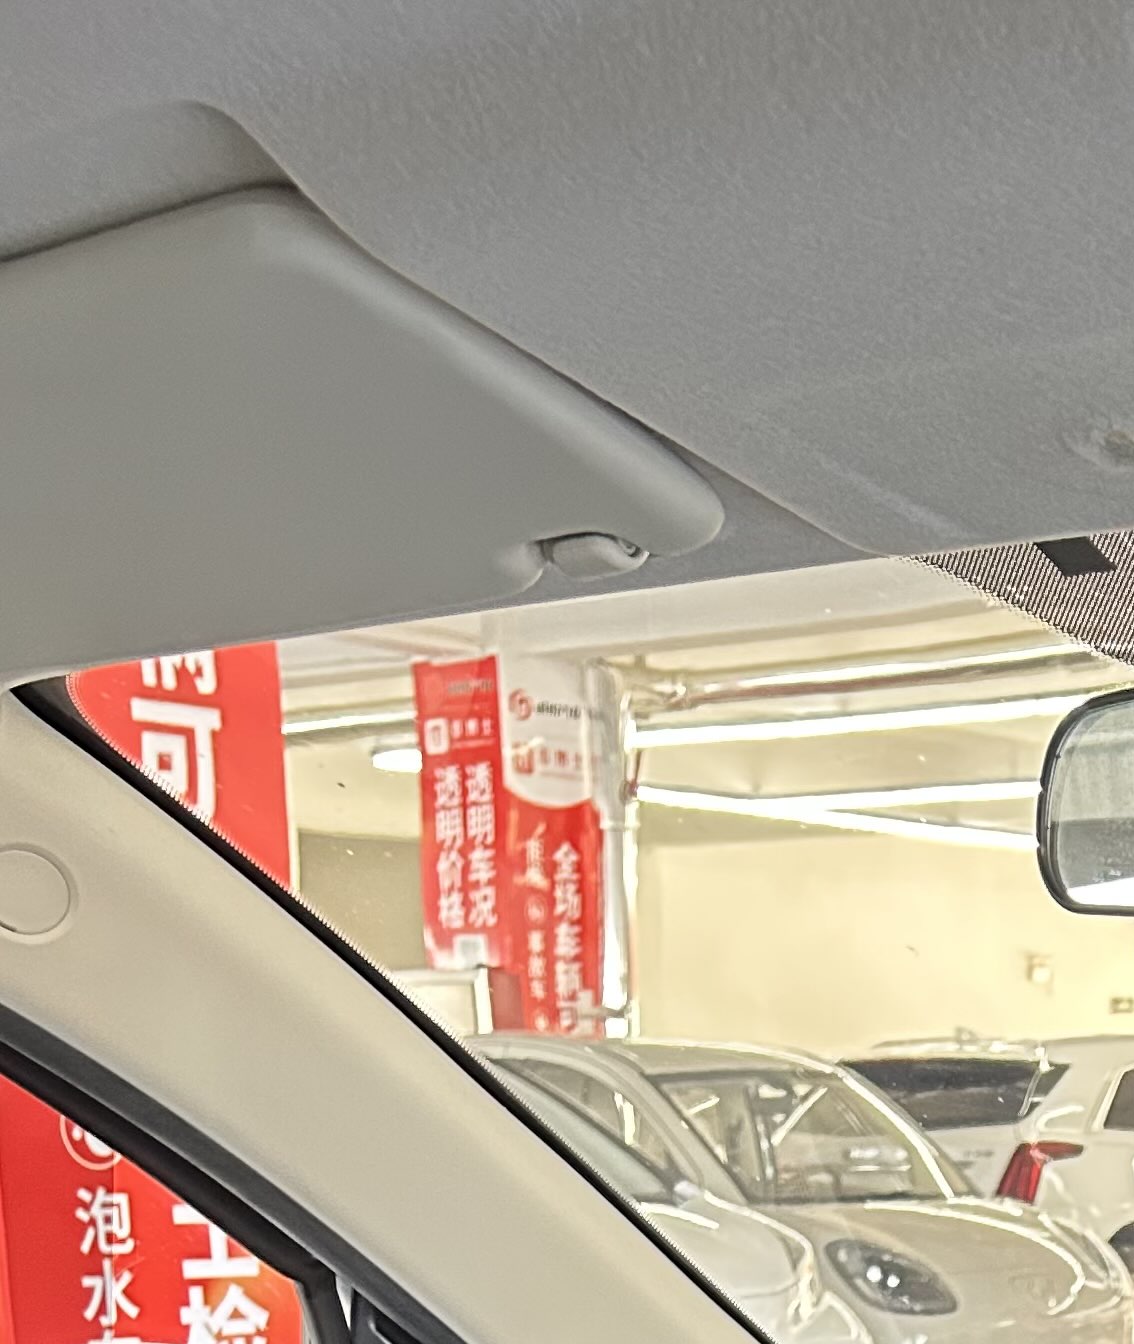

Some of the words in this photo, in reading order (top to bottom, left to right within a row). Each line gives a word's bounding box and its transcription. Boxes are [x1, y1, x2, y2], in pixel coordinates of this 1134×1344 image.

[434, 763, 466, 929] 透明价格
[465, 761, 498, 928] 透明车况
